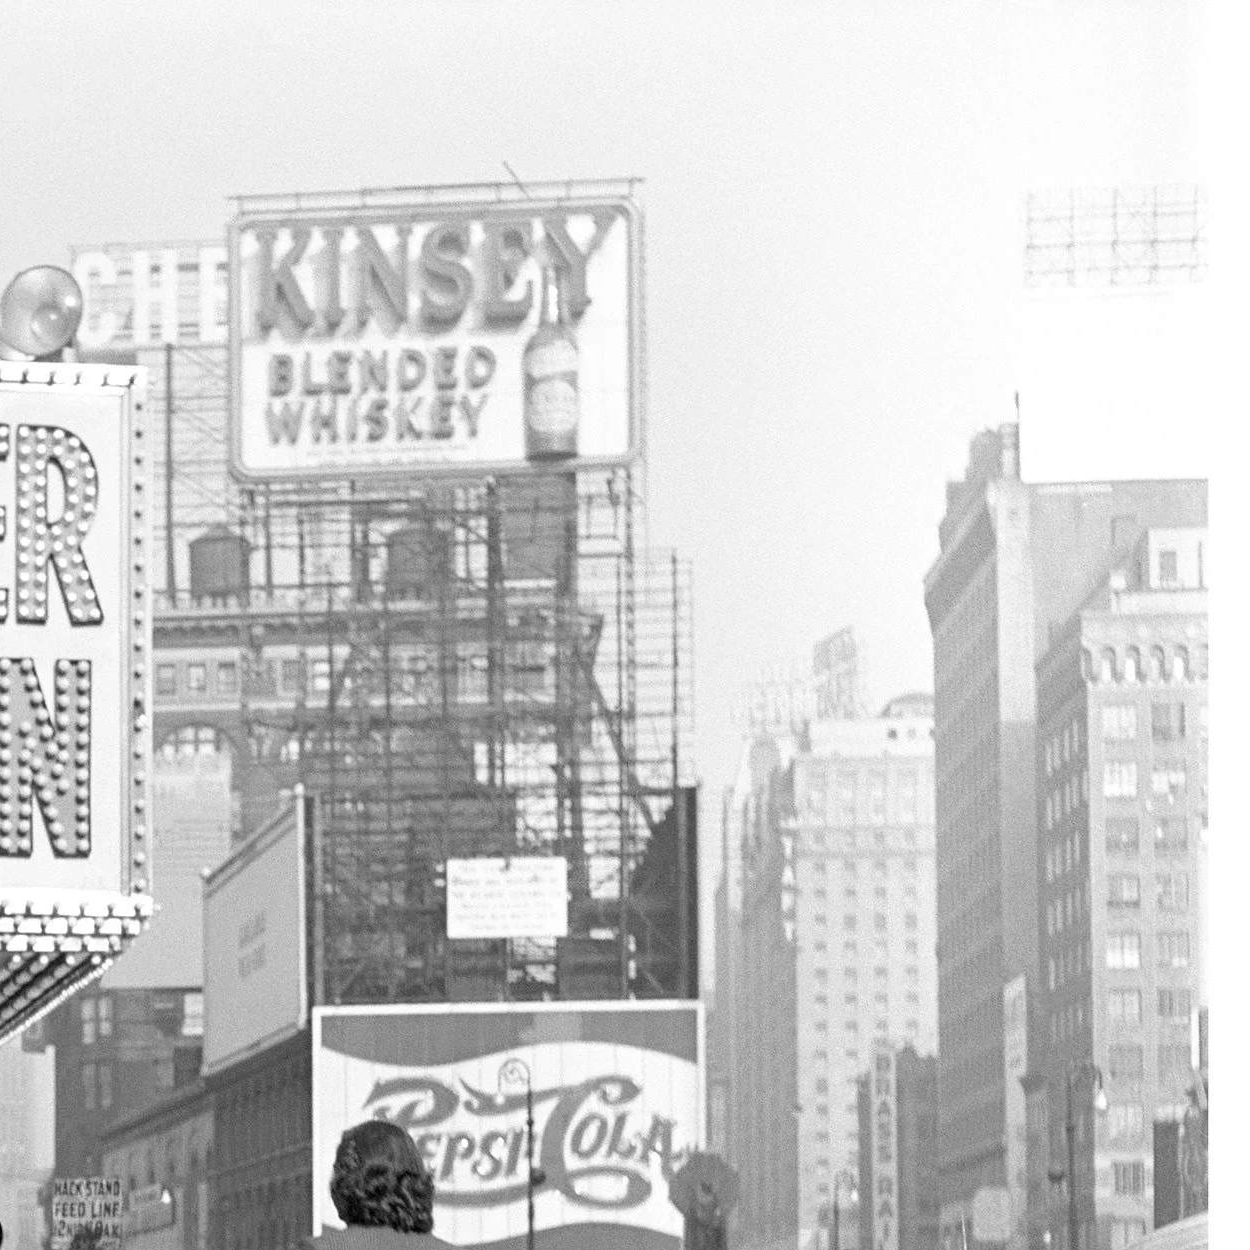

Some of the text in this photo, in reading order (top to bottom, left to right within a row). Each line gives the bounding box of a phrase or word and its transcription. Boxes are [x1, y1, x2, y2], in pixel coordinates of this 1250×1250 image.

[247, 208, 619, 338] KINSEY
[266, 344, 498, 397] BLENDED
[263, 394, 490, 446] WHISKEY
[54, 1180, 120, 1196] HACK STAND
[54, 1201, 119, 1219] FEED LINE
